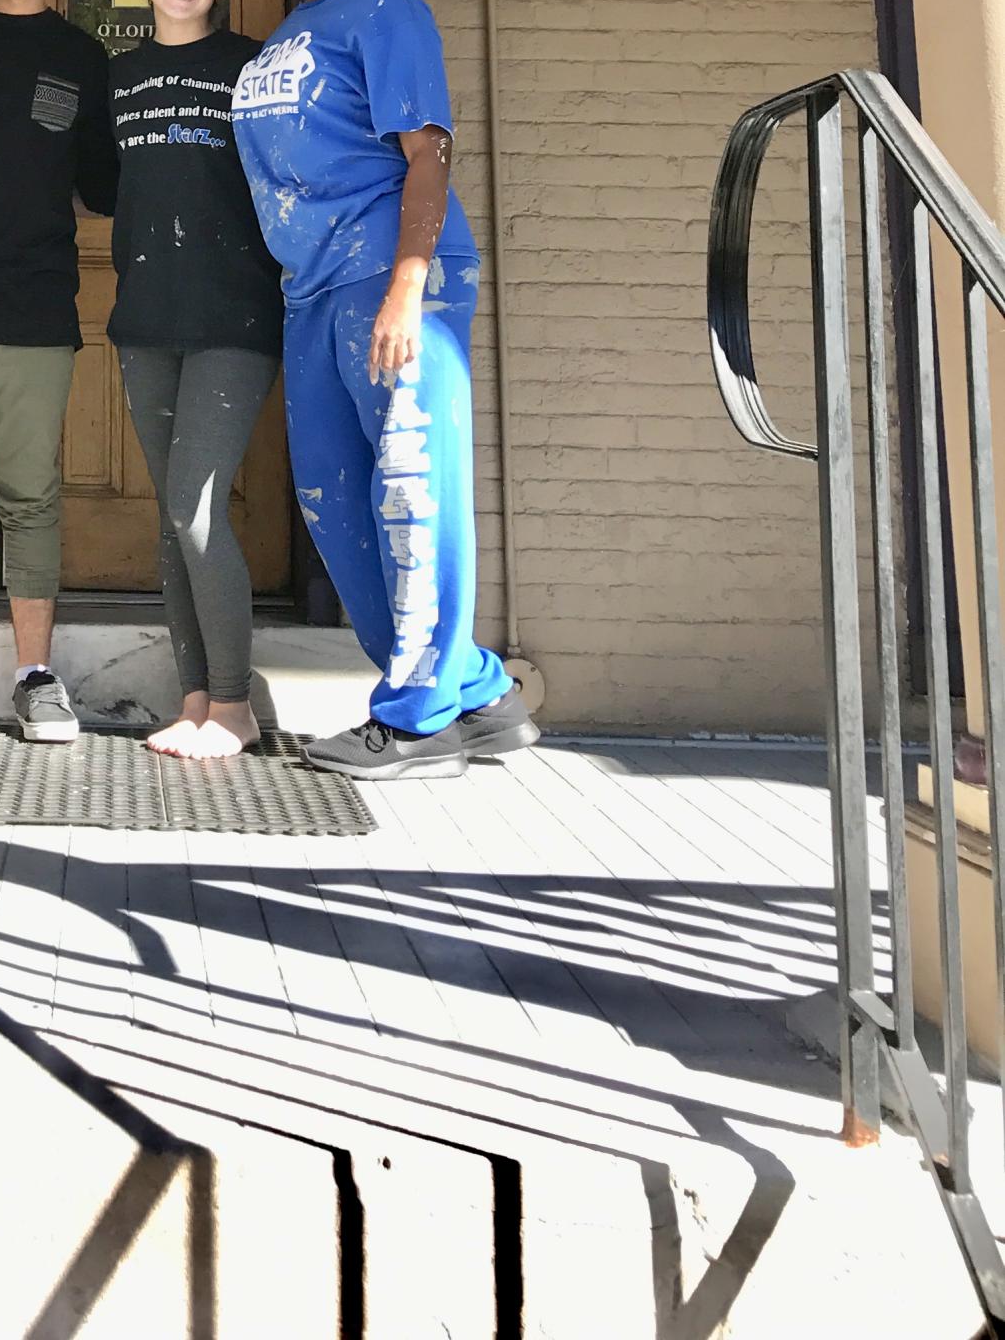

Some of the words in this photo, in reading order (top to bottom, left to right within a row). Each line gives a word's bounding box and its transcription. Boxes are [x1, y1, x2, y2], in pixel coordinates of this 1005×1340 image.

[114, 88, 130, 100] The
[131, 76, 164, 95] making
[166, 76, 180, 85] of
[240, 70, 294, 100] STATE
[116, 111, 140, 127] Takes
[143, 106, 175, 119] talent
[178, 106, 200, 117] and
[128, 135, 144, 147] are
[147, 132, 166, 144] the
